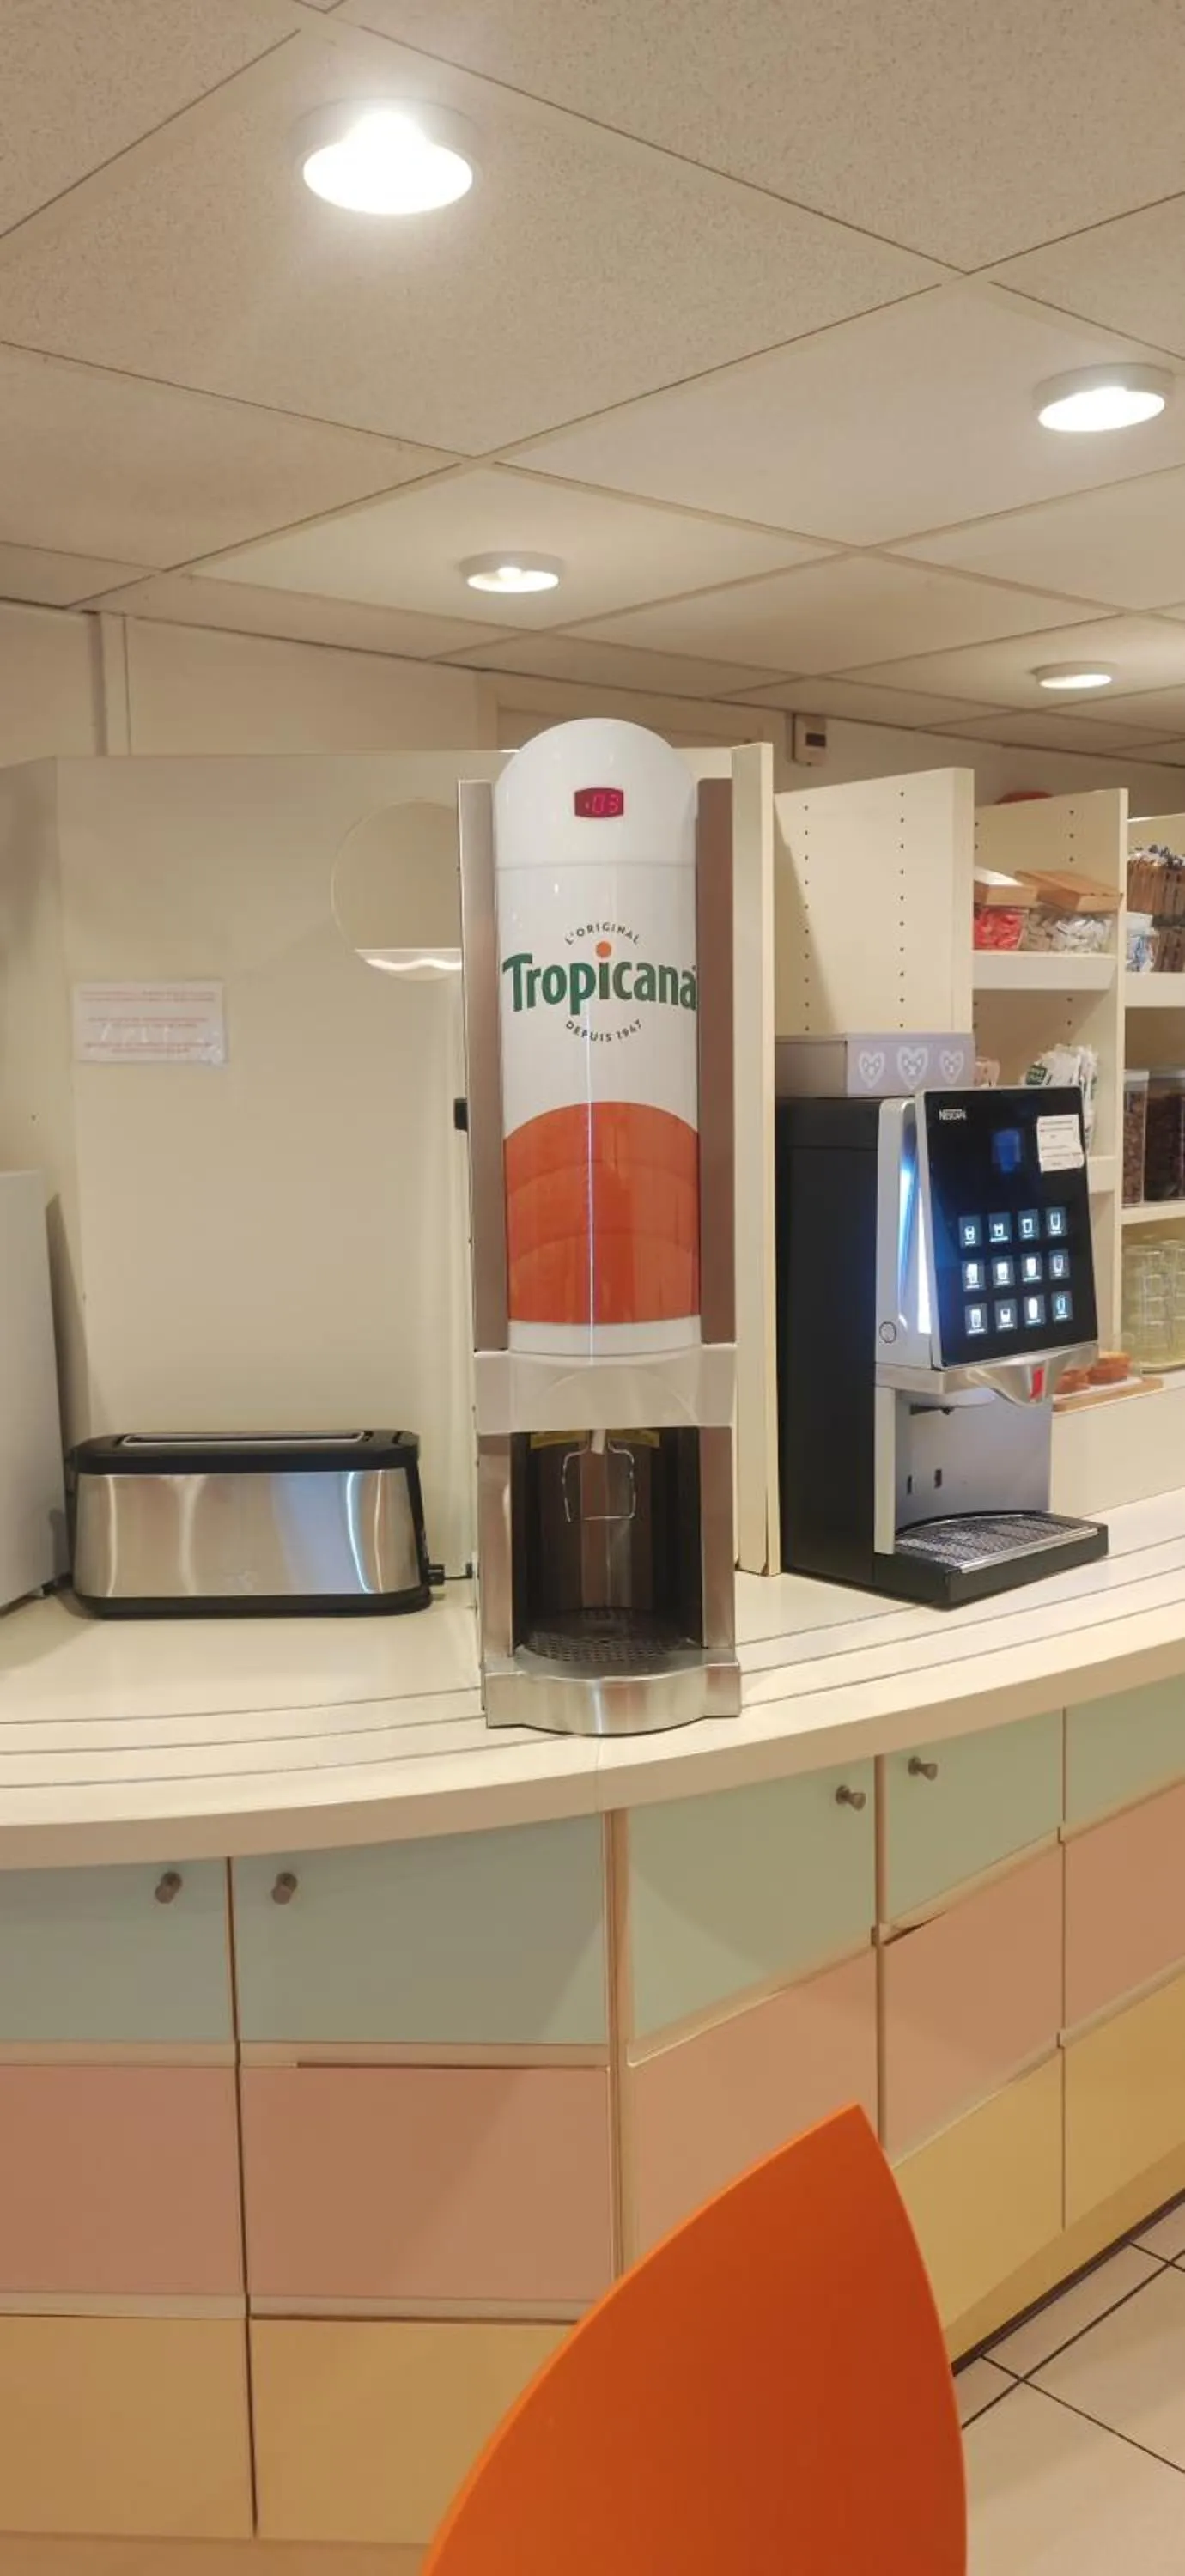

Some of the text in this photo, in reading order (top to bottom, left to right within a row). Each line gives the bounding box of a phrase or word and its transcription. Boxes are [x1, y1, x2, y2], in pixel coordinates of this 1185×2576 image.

[565, 921, 641, 945] L'ORIGINAL
[502, 941, 696, 1015] Tropicana
[565, 1018, 642, 1042] DEPUIS 1947
